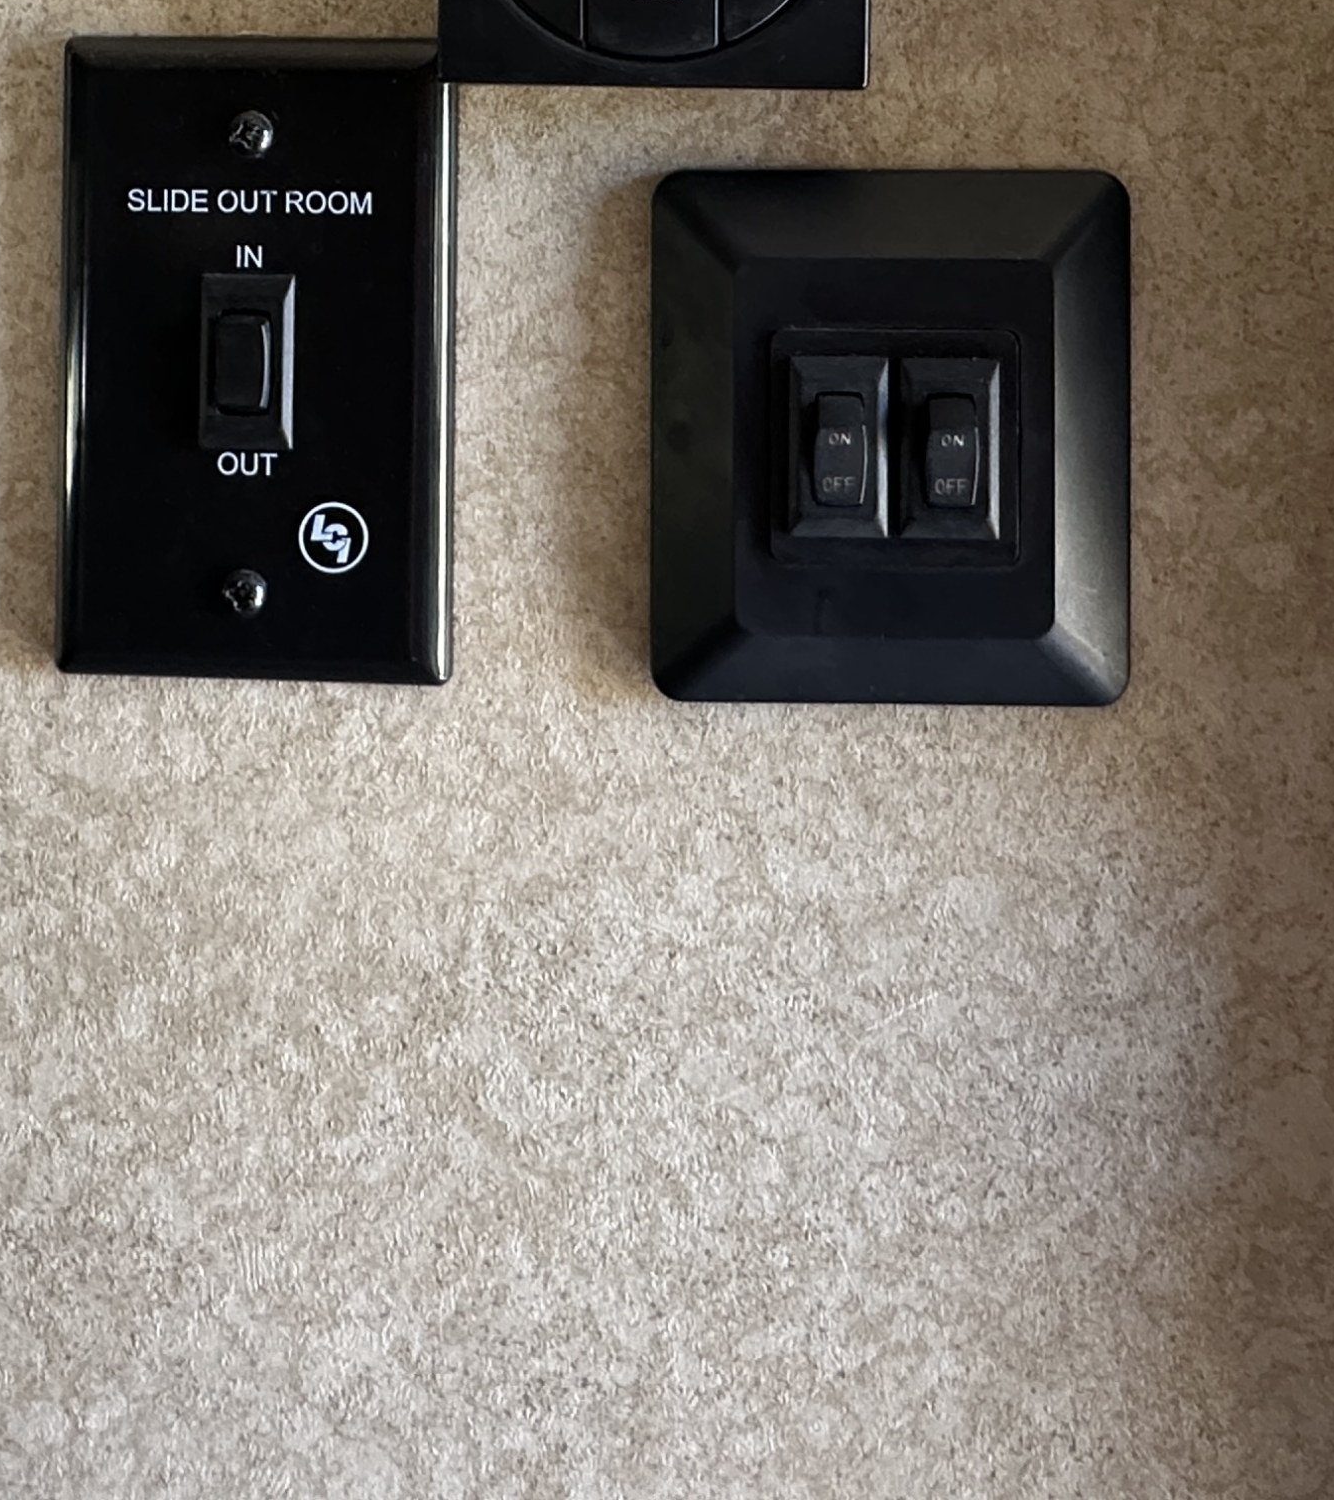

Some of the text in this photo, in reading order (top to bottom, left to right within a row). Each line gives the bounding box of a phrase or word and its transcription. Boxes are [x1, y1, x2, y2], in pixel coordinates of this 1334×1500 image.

[127, 188, 373, 215] SLIDE OUT ROOM
[236, 244, 263, 269] IN
[829, 433, 851, 445] ON
[941, 435, 965, 447] ON
[217, 451, 278, 476] OUT
[822, 476, 855, 493] OFF
[934, 478, 967, 495] OFF
